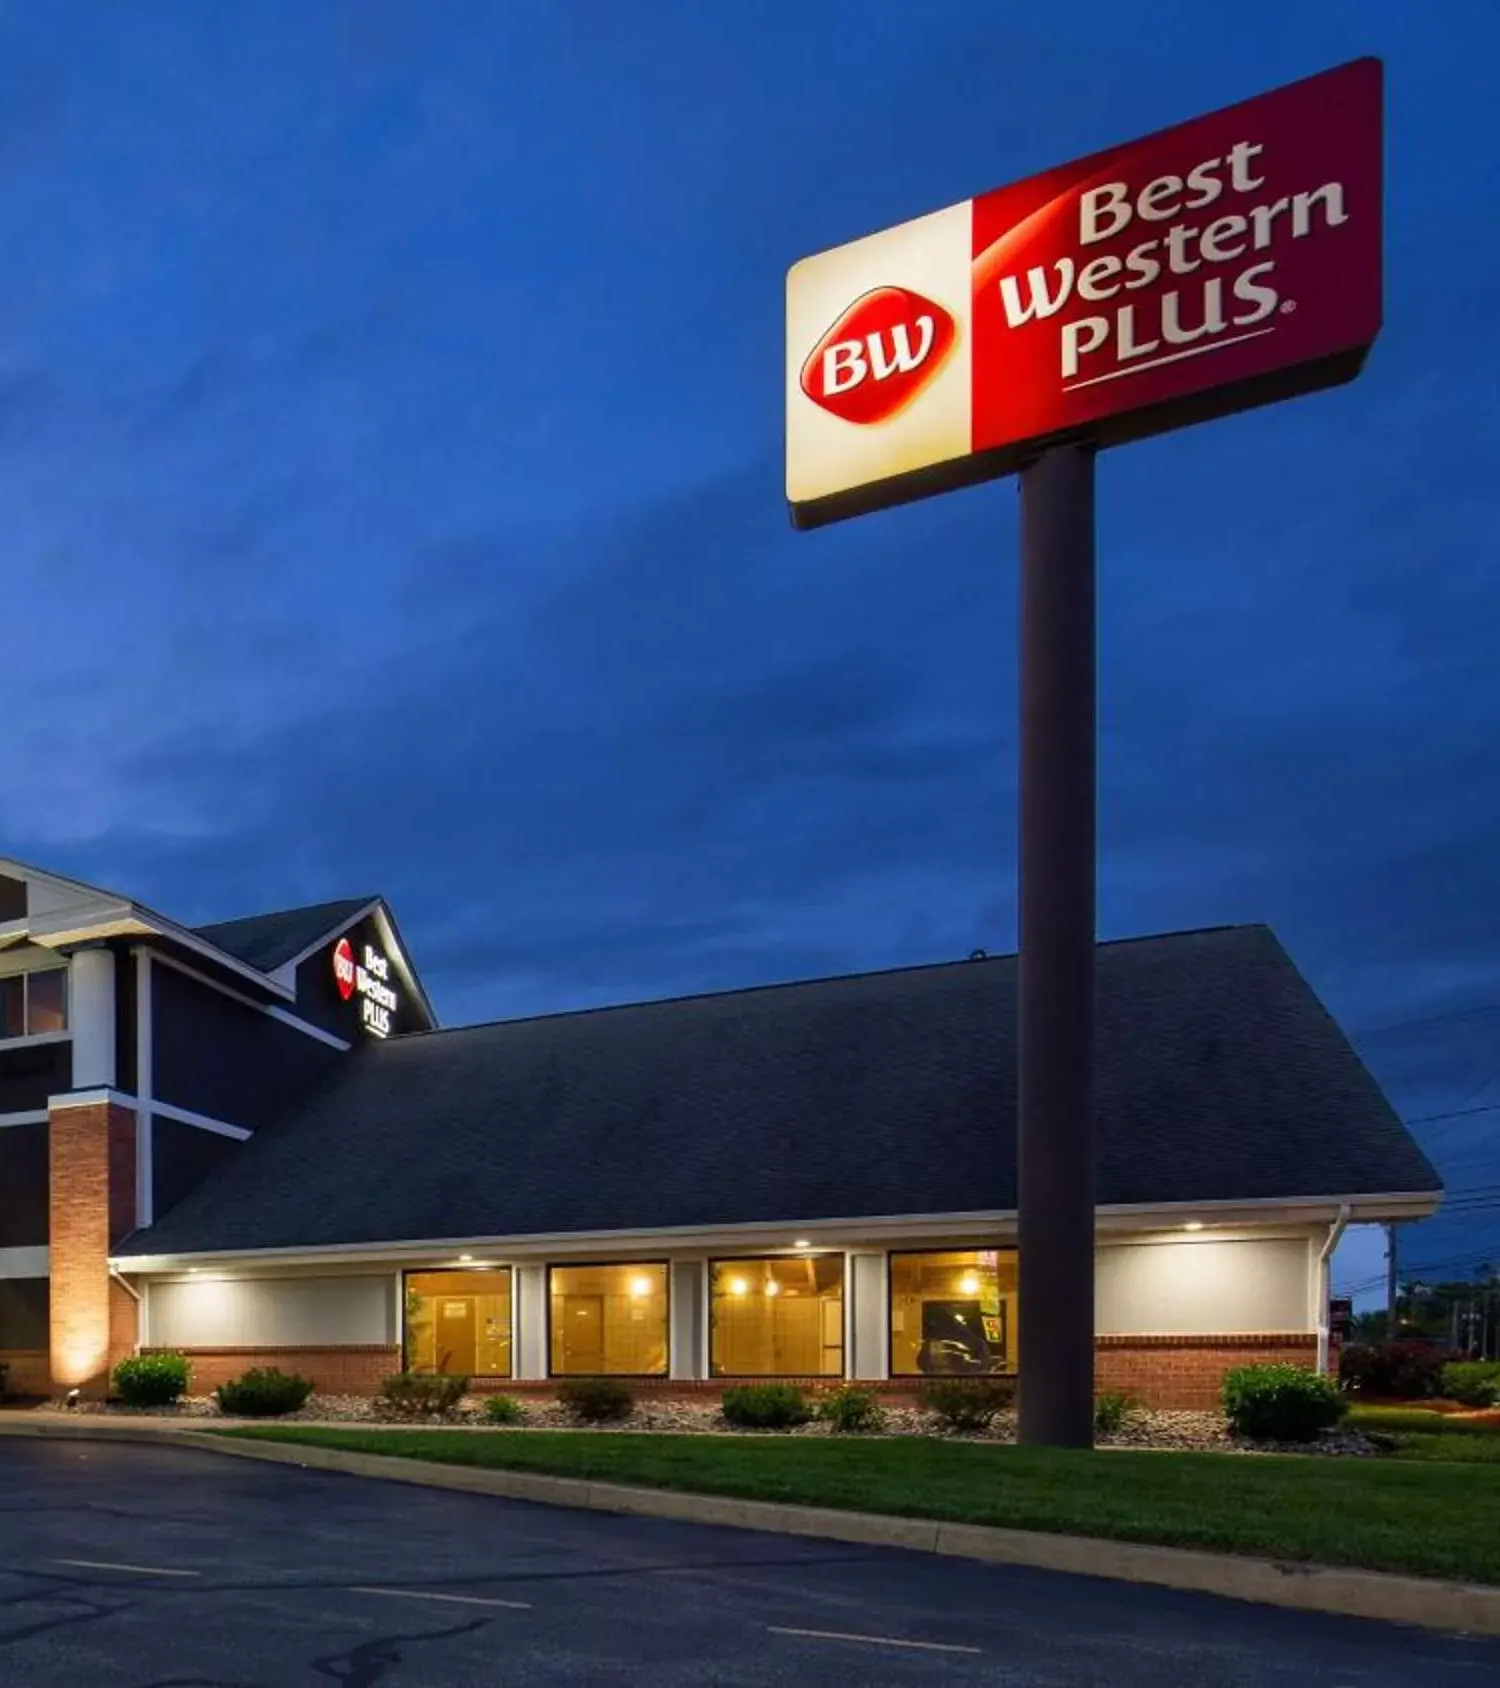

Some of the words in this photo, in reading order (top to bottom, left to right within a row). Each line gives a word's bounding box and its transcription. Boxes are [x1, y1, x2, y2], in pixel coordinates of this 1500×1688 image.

[1079, 140, 1265, 246] Best
[999, 181, 1349, 329] Western
[821, 315, 935, 397] BW
[365, 945, 389, 981] Best
[363, 998, 390, 1034] PLUS
